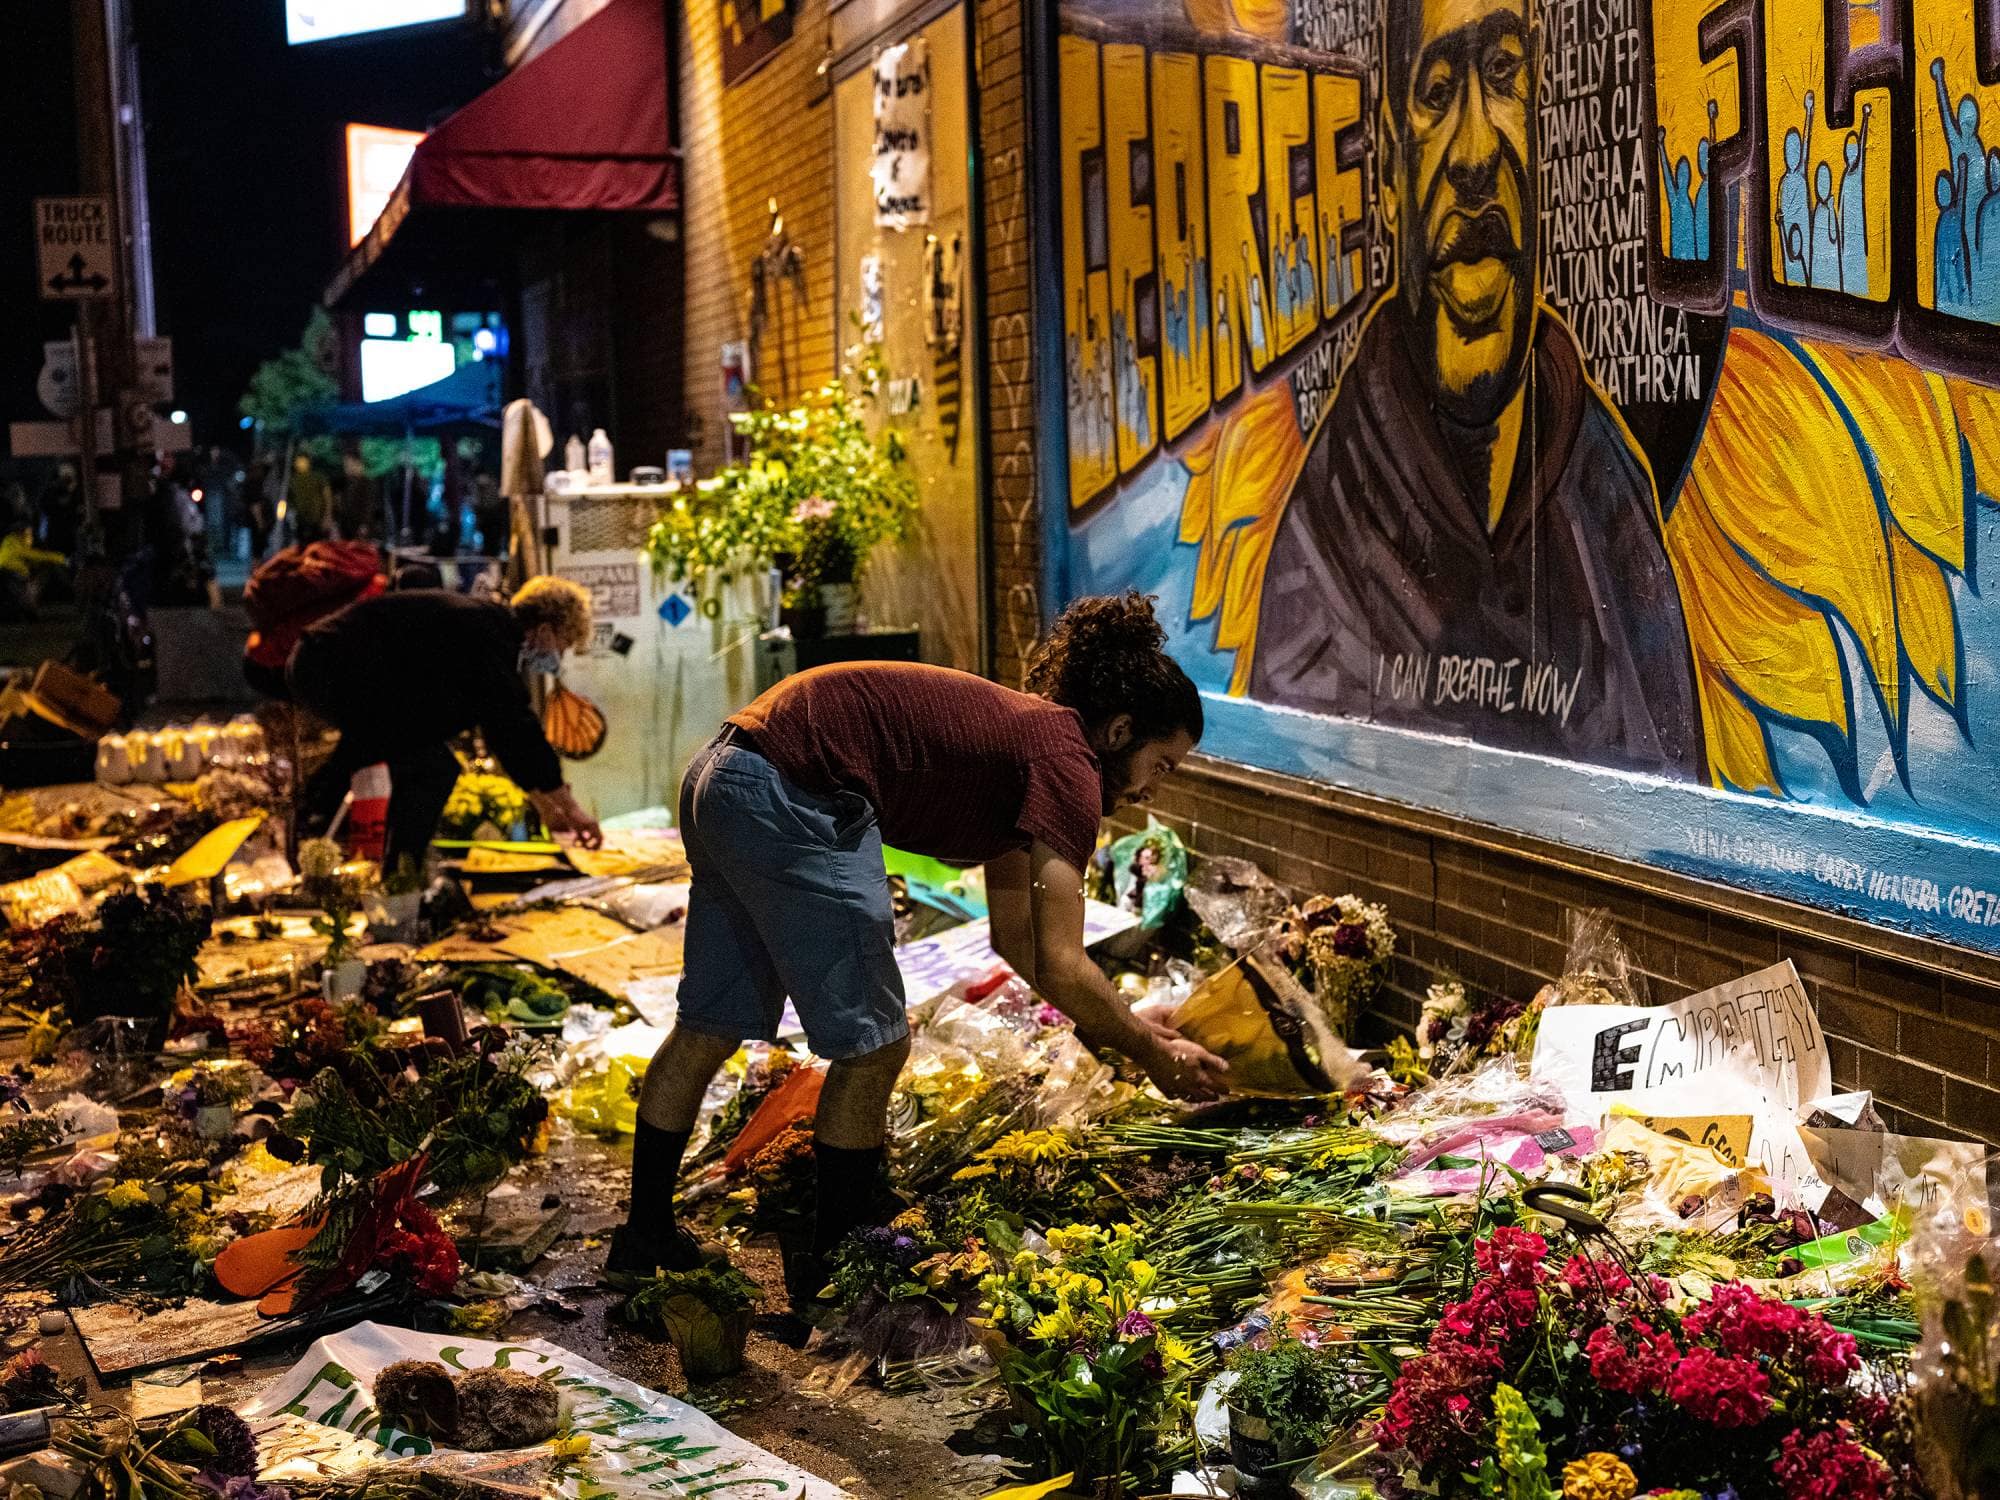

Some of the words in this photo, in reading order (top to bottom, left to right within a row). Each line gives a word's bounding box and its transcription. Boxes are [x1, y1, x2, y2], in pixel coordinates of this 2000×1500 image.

[1541, 39, 1607, 106] SHELLY
[42, 202, 105, 222] TRUCK
[42, 223, 107, 245] ROUTE
[1060, 34, 1364, 509] GEORGE
[1594, 353, 1700, 406] KATHRYN
[1375, 653, 1384, 696] I
[1391, 652, 1432, 700] CAN
[1434, 654, 1521, 713] BREATHE
[1521, 659, 1583, 728] NOW
[1591, 984, 1816, 1093] EMPATHY
